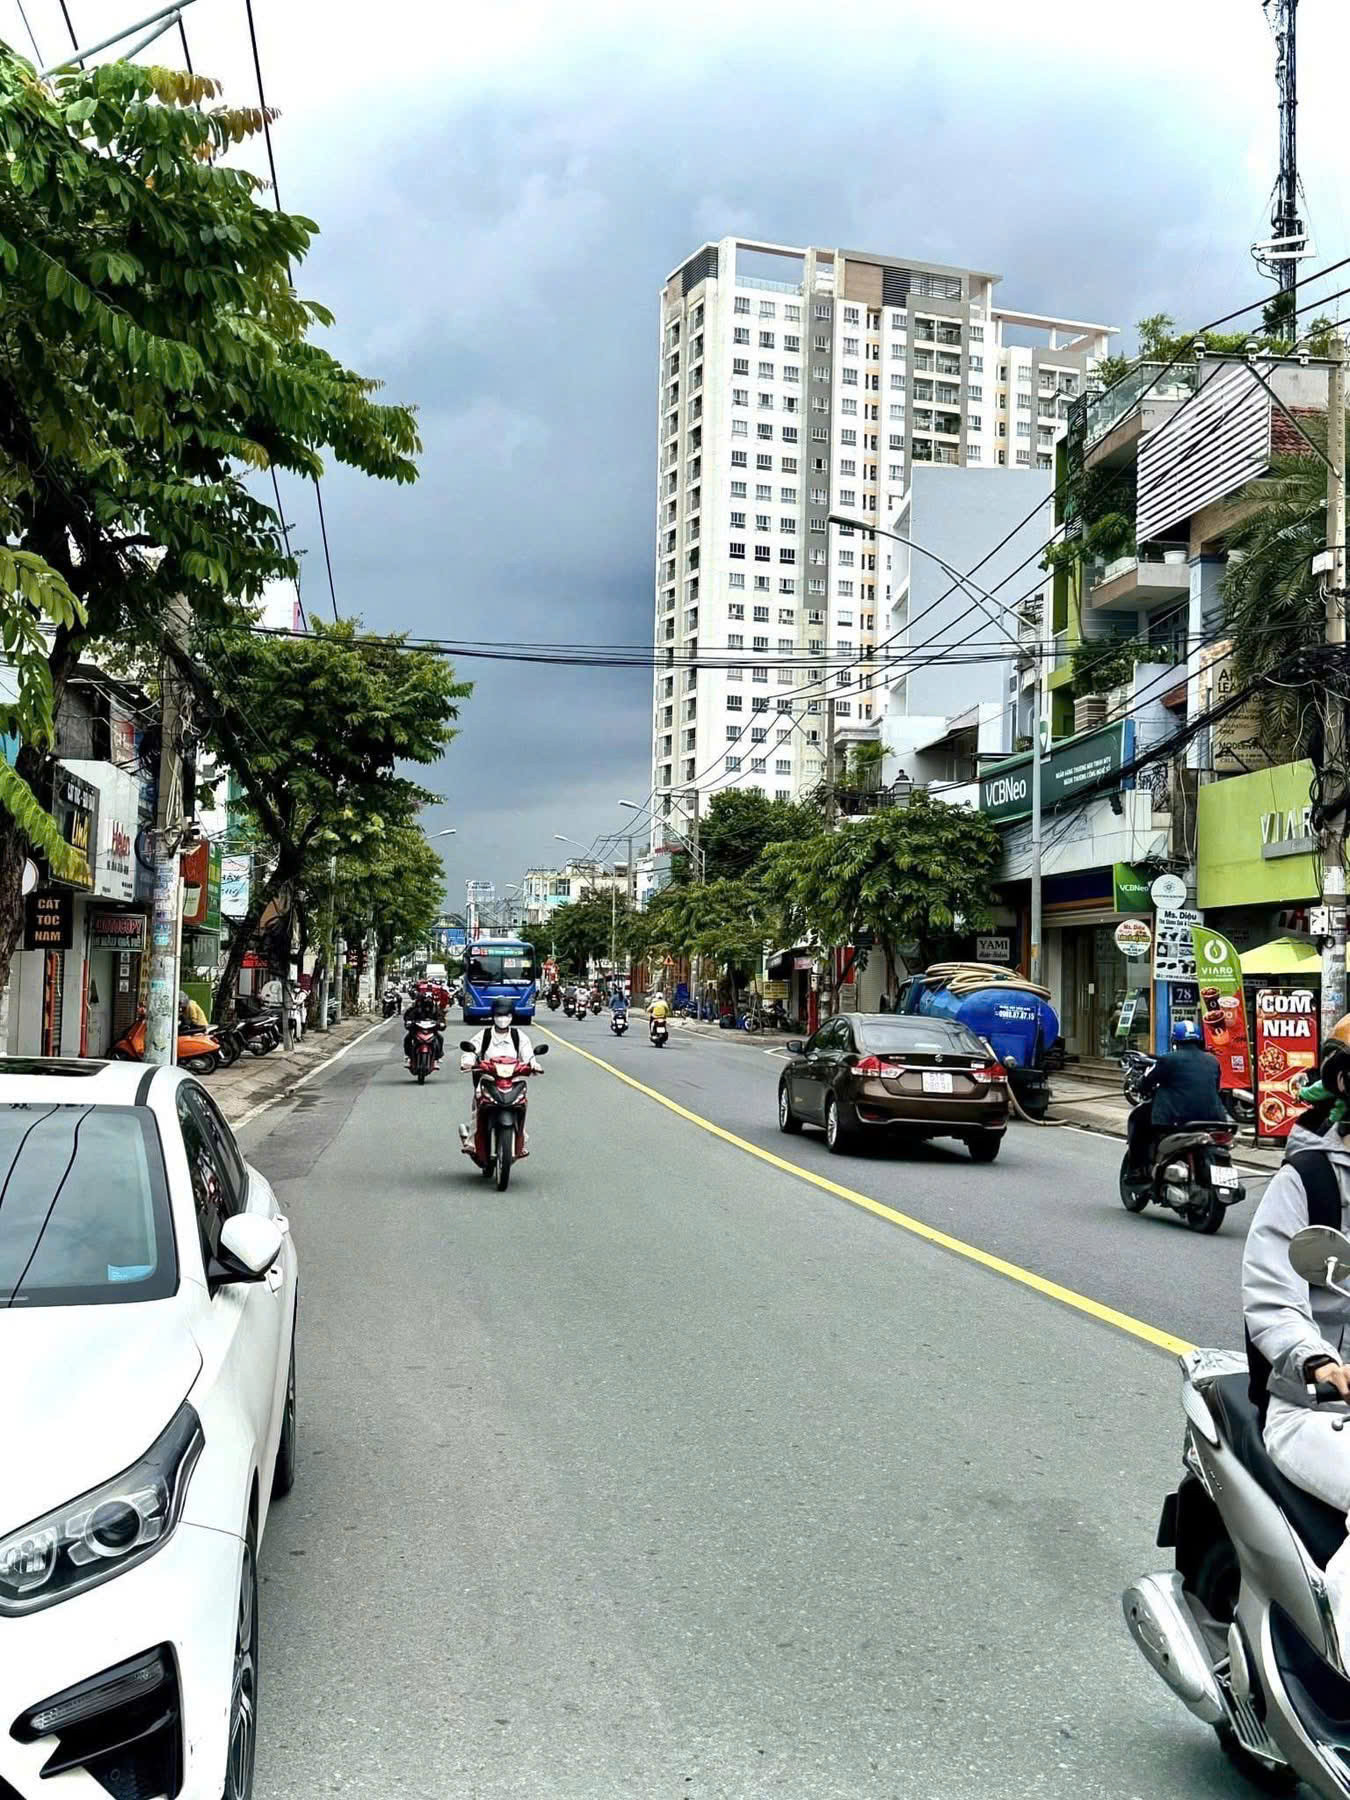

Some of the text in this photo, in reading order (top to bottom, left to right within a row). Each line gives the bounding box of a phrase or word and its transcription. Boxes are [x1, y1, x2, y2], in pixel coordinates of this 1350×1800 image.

[985, 776, 1027, 808] VCBNeo
[1260, 805, 1314, 844] VIAR
[1119, 884, 1149, 892] VCBNeo
[1164, 910, 1178, 919] Ms.
[34, 930, 61, 942] NAM
[978, 939, 1008, 950] YAMI
[1201, 966, 1233, 975] VIARO
[1176, 988, 1192, 1000] 78
